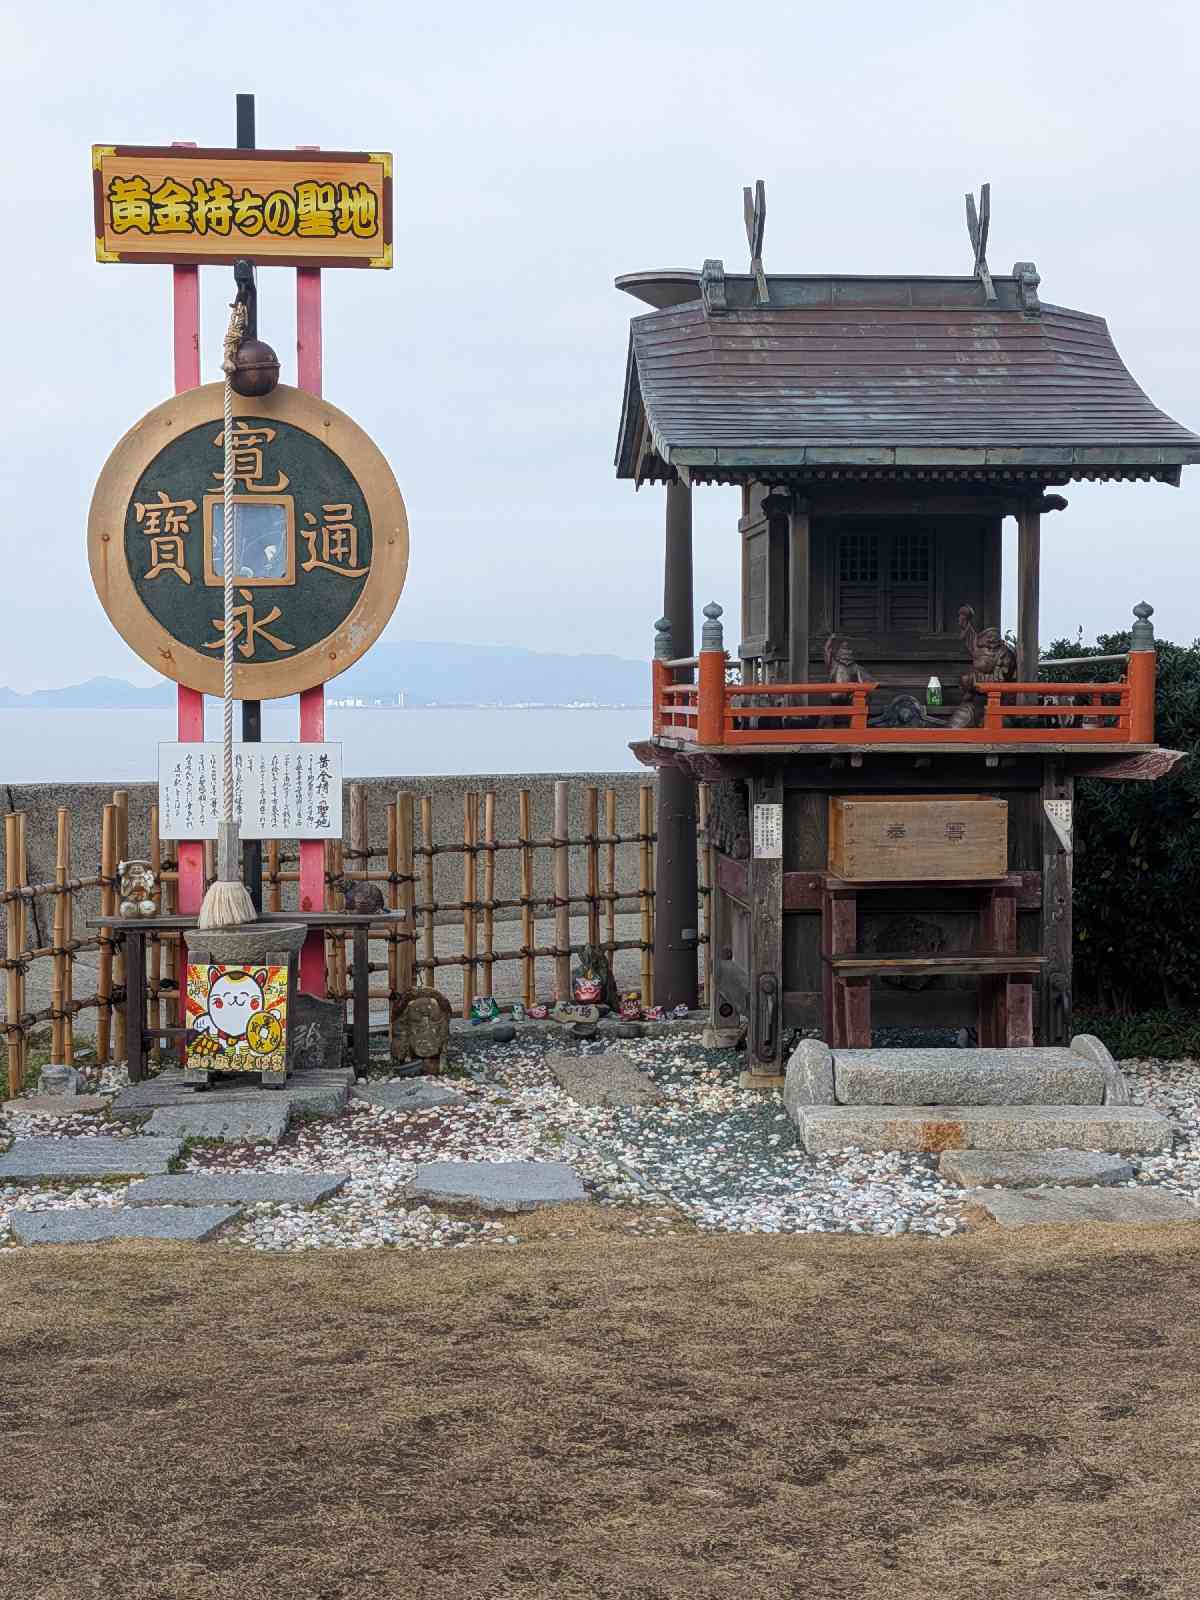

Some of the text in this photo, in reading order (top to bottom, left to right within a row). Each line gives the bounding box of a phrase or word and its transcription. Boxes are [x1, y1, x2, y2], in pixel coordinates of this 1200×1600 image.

[109, 175, 379, 238] 黄金持ちの聖地
[300, 503, 370, 578] 通
[200, 589, 296, 658] 永
